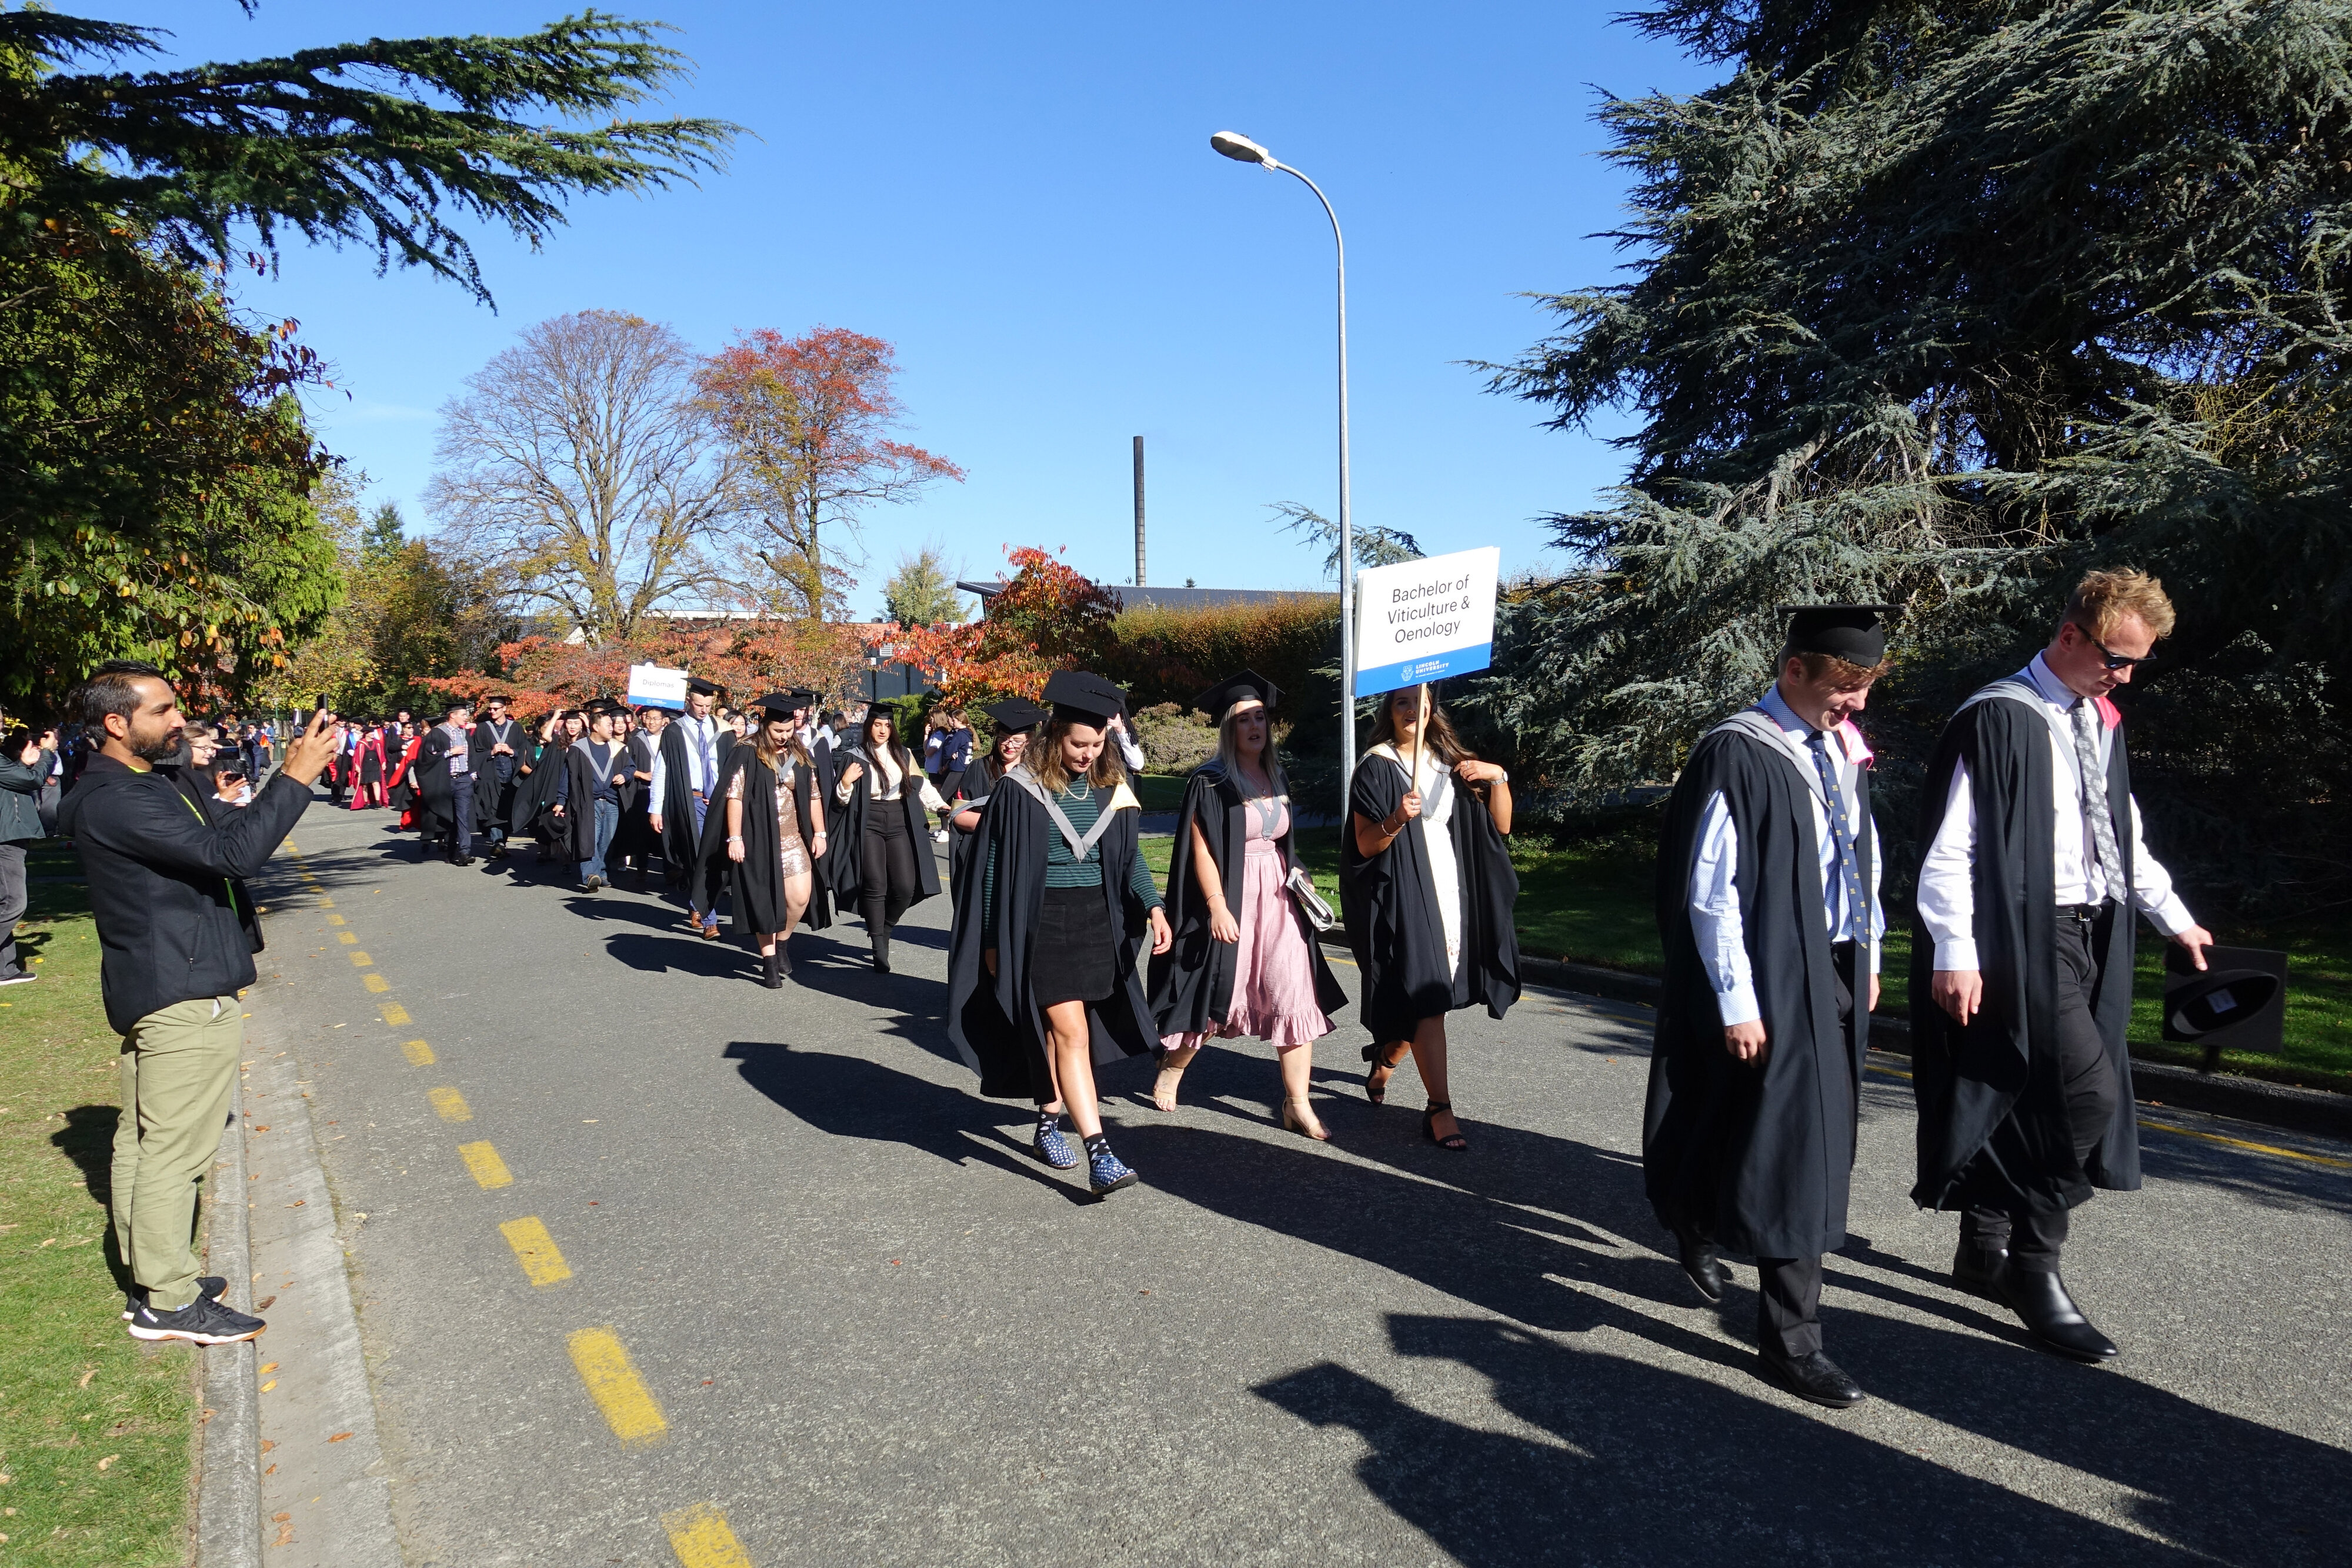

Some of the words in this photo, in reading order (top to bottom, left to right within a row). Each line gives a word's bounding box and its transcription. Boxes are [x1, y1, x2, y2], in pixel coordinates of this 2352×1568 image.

[1392, 580, 1452, 603] Bachelor
[1456, 574, 1470, 590] of
[1388, 601, 1457, 624] Viticulture
[1461, 596, 1470, 609] &
[1395, 620, 1460, 643] Oenology
[1415, 662, 1449, 674] UNIVERSITY
[1416, 660, 1439, 669] LINCOLN
[642, 679, 675, 688] Diplomas
[143, 1308, 159, 1323] Reebok
